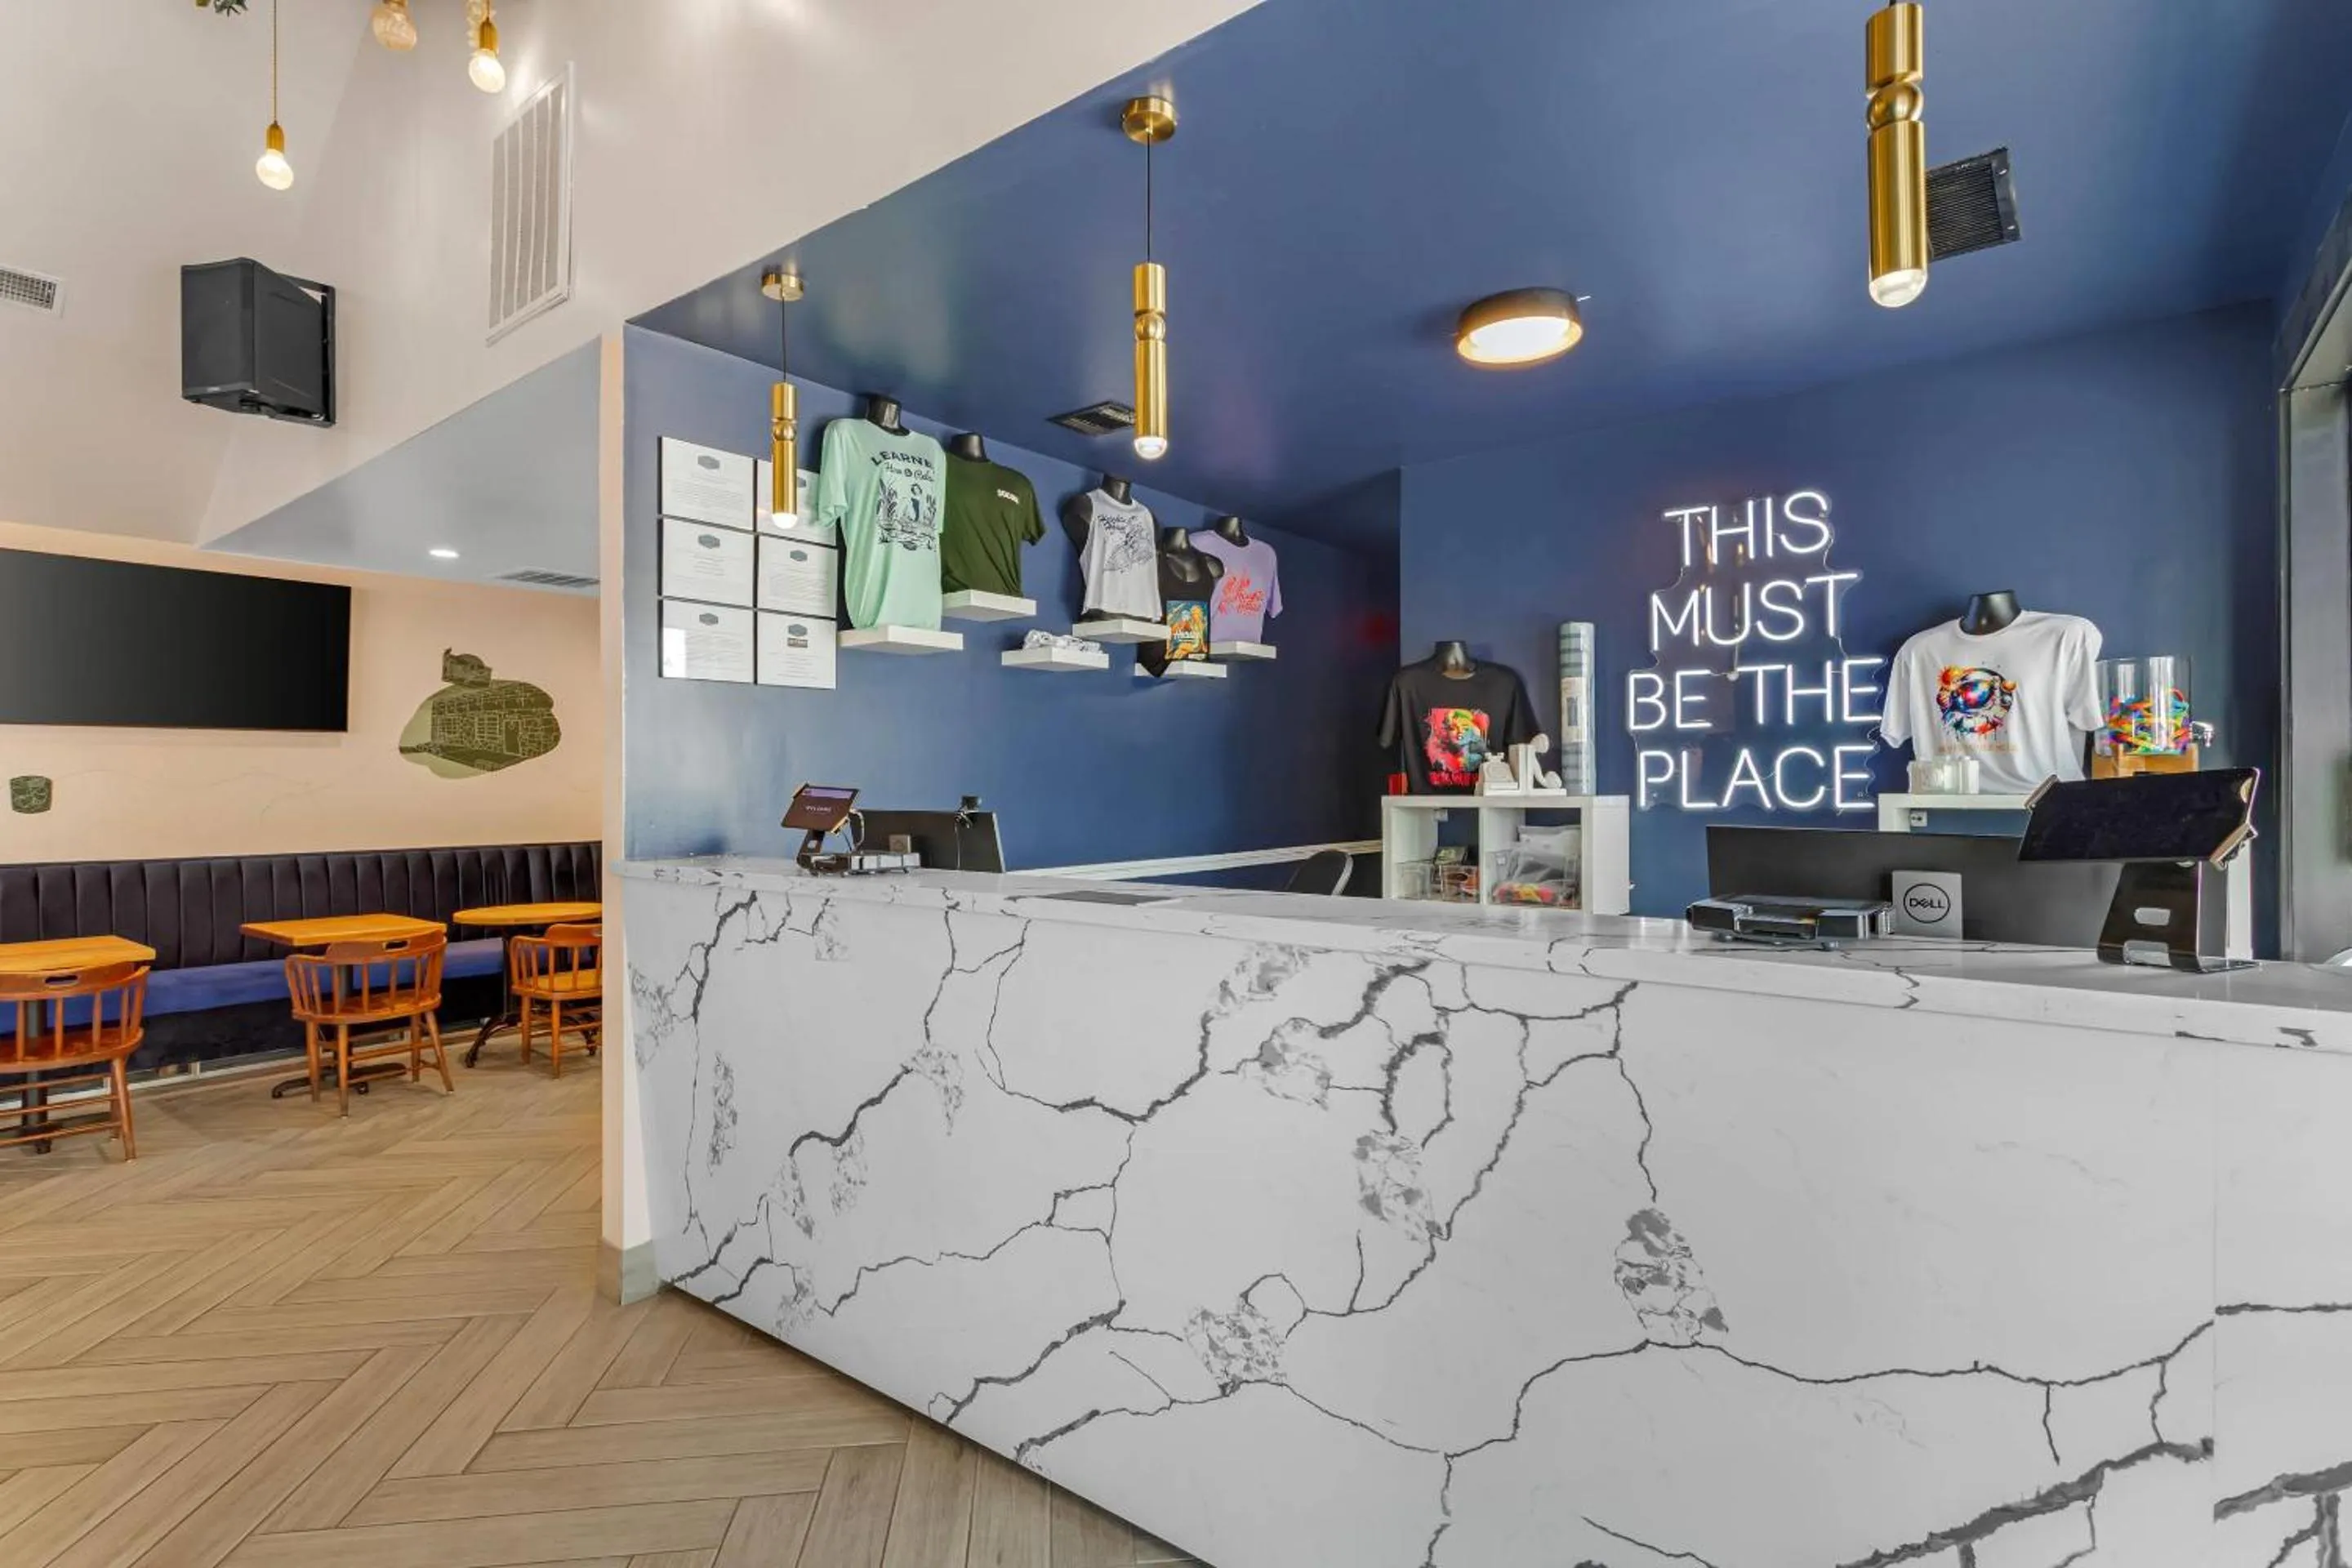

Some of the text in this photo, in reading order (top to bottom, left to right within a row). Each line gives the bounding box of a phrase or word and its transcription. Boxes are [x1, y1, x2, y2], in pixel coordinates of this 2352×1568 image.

[1664, 491, 1831, 567] THIS
[1651, 572, 1859, 651] MUST
[1628, 657, 1884, 731] BE THE
[1639, 746, 1877, 809] PLACE
[1909, 898, 1946, 908] DELL
